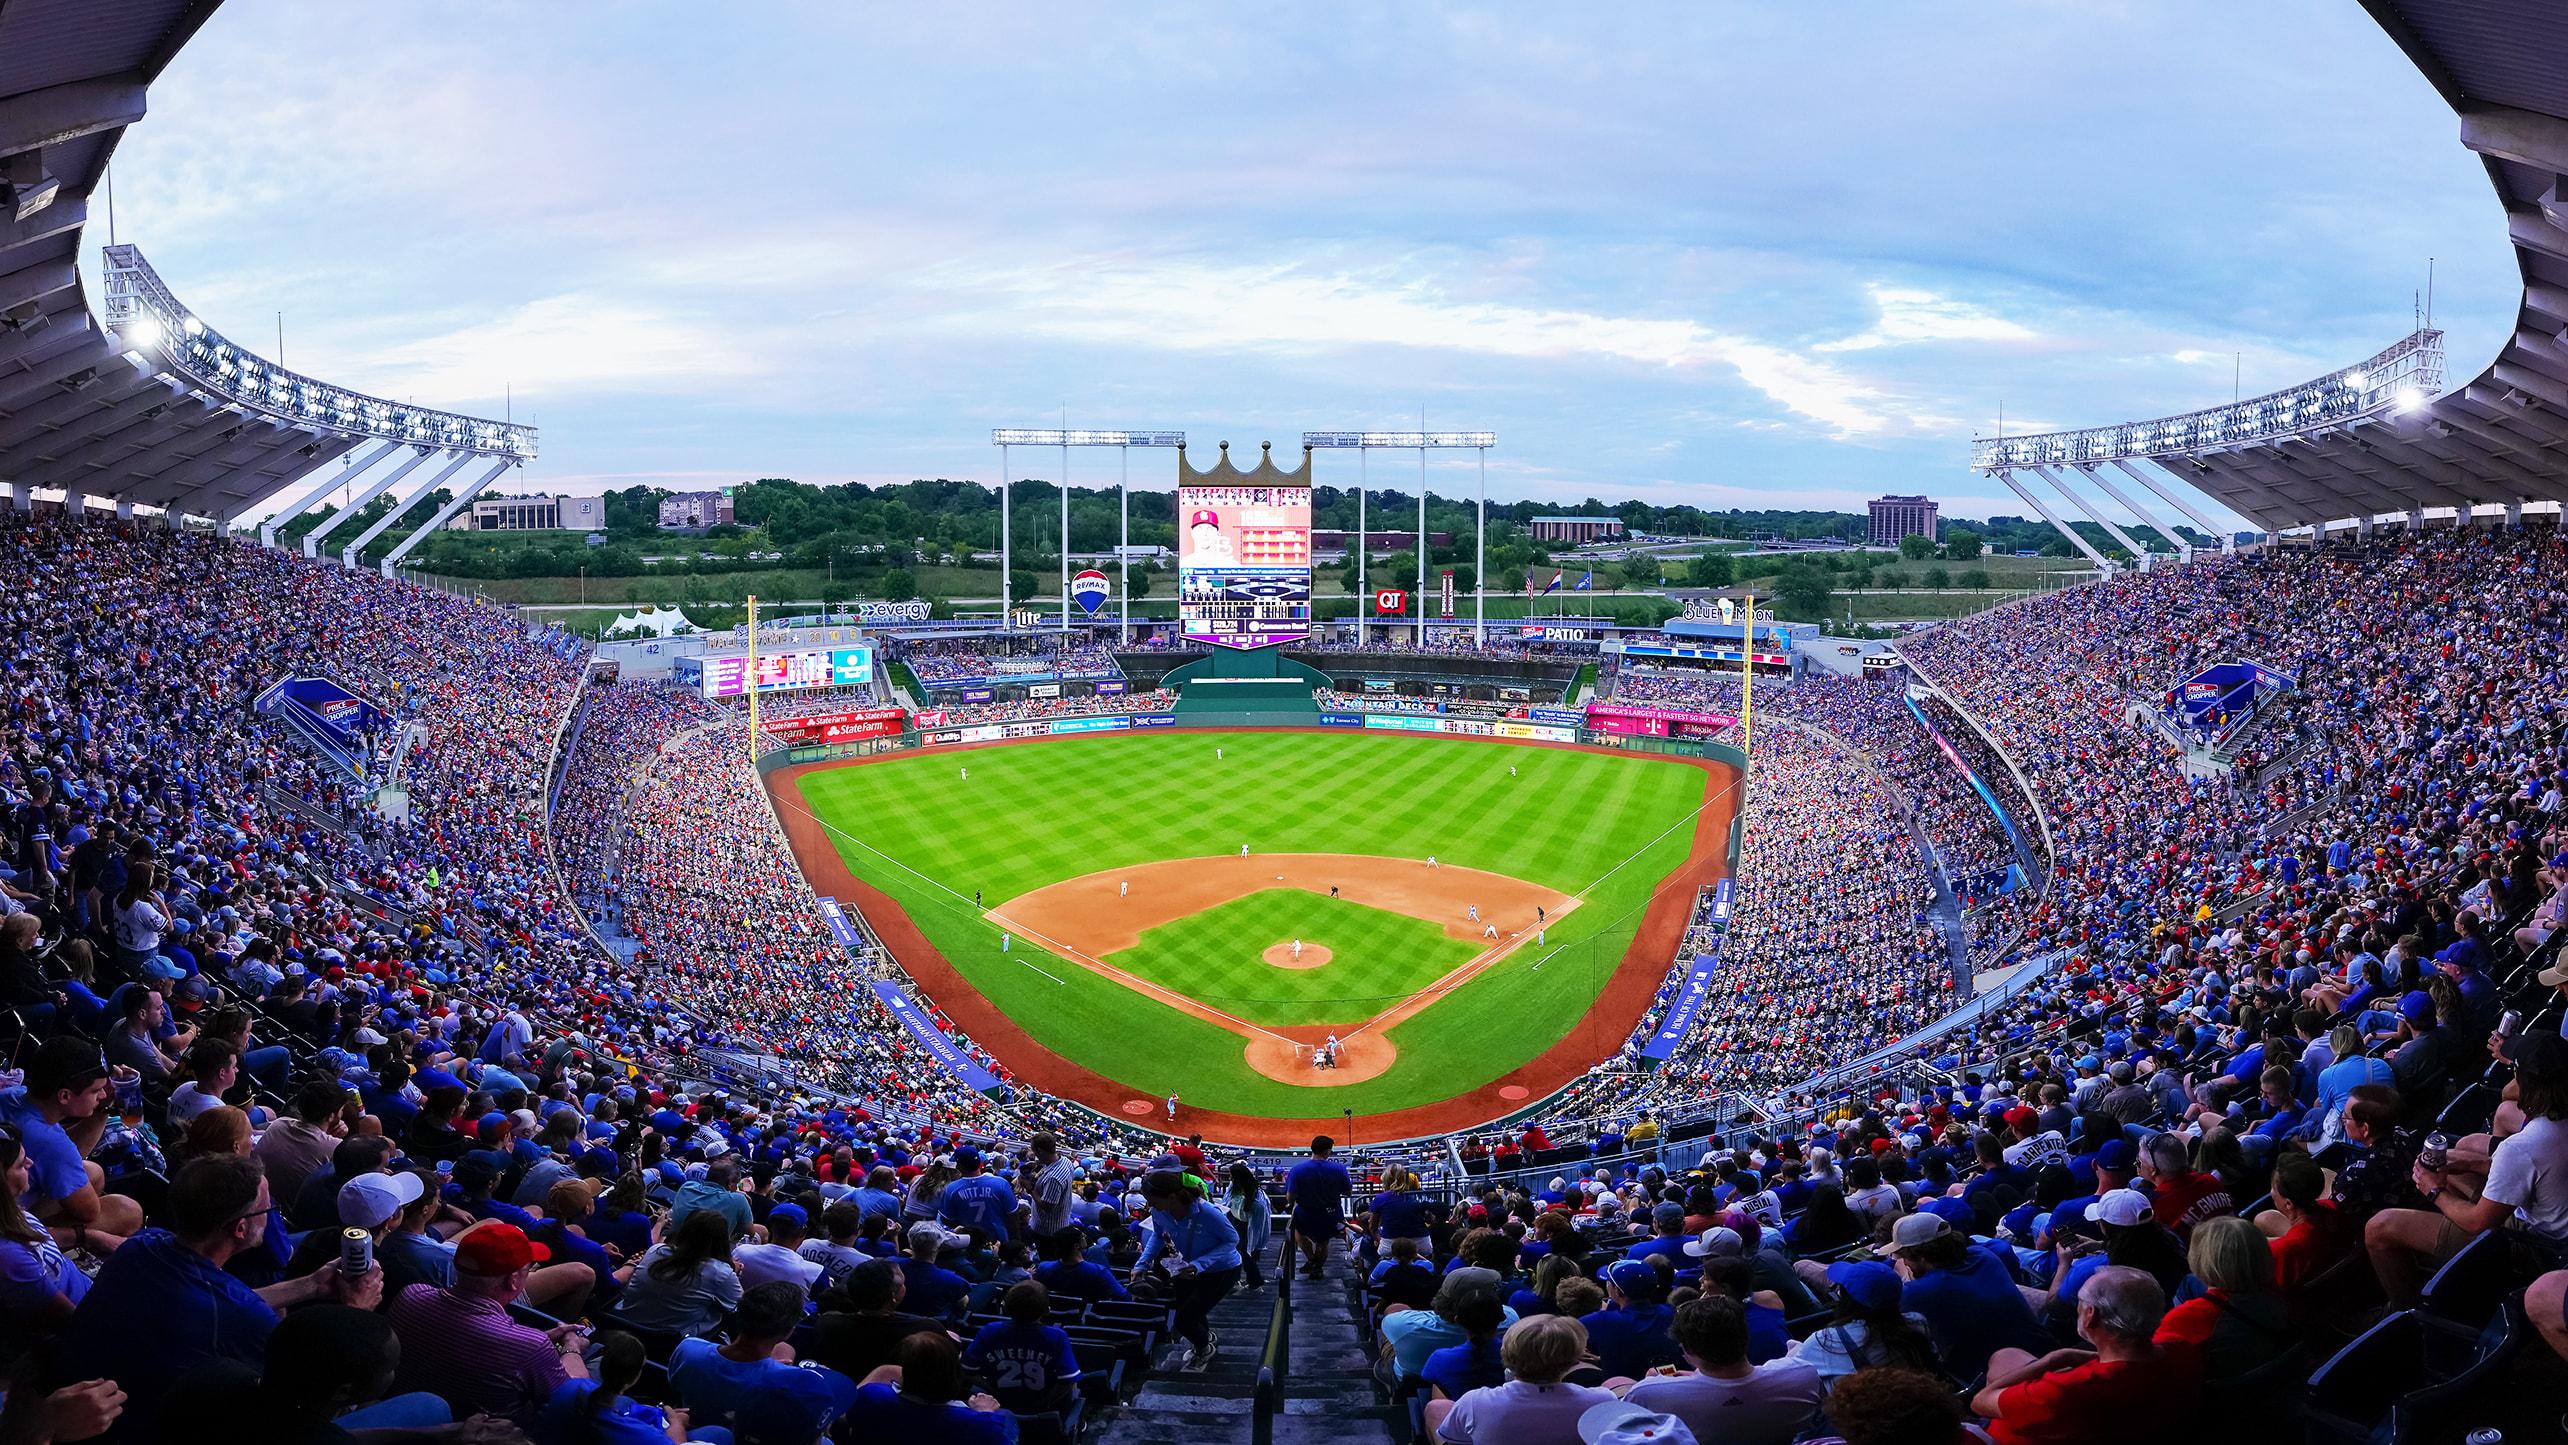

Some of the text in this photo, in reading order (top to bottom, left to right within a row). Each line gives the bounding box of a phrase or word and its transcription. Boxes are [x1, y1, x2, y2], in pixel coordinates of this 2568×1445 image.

[1076, 581, 1106, 590] RE/MAX
[1379, 592, 1401, 610] QT
[876, 603, 932, 619] evergy
[1683, 602, 1719, 621] BLUE
[1016, 611, 1041, 628] Lite
[809, 633, 821, 642] 20
[829, 631, 839, 641] 10
[850, 630, 856, 640] 5
[1545, 628, 1584, 641] PATIO
[646, 644, 659, 654] 42
[708, 637, 739, 649] HALL
[2187, 691, 2217, 700] CHOPPER
[2188, 685, 2206, 693] PRICE
[326, 701, 347, 713] PRICE
[1344, 700, 1424, 711] FOUNTAIN DECK
[326, 707, 359, 722] CHOPPER
[922, 717, 940, 725] SONIC
[1594, 706, 1628, 715] AMERICA'S
[1629, 709, 1657, 717] LARGEST
[1663, 712, 1689, 720] FASTEST
[1699, 715, 1730, 725] NETWORK
[1671, 995, 1697, 1030] HOME OF THE
[900, 1010, 958, 1061] KAUFFMAN STADIUM
[1774, 1102, 1784, 1111] 13
[958, 1187, 993, 1200] WITT JR.
[968, 1201, 986, 1223] 7
[1741, 1197, 1773, 1215] MUSIAL
[346, 1247, 370, 1273] Lite
[801, 1249, 853, 1276] HOSMER
[986, 1348, 1053, 1366] SWEENEY
[996, 1360, 1046, 1391] 29
